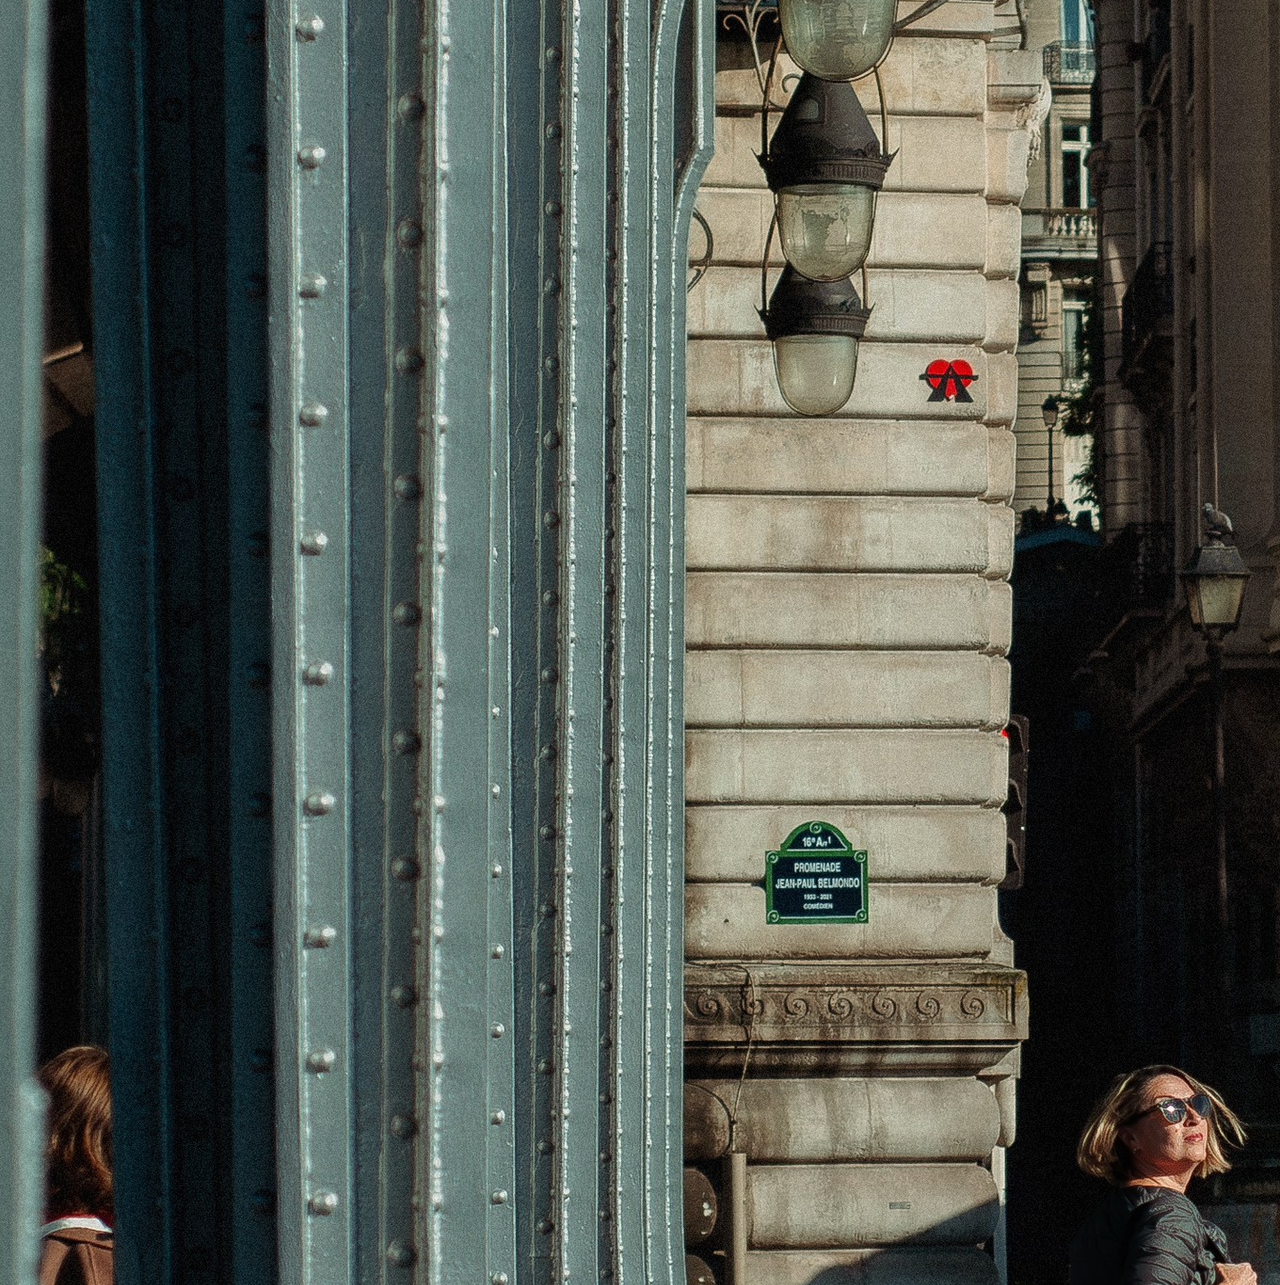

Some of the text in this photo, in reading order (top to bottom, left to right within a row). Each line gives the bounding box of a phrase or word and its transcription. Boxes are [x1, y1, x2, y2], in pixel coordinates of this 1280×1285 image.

[794, 862, 841, 873] PROMENADE
[775, 877, 860, 889] JEAN-PAUL BELMONDO
